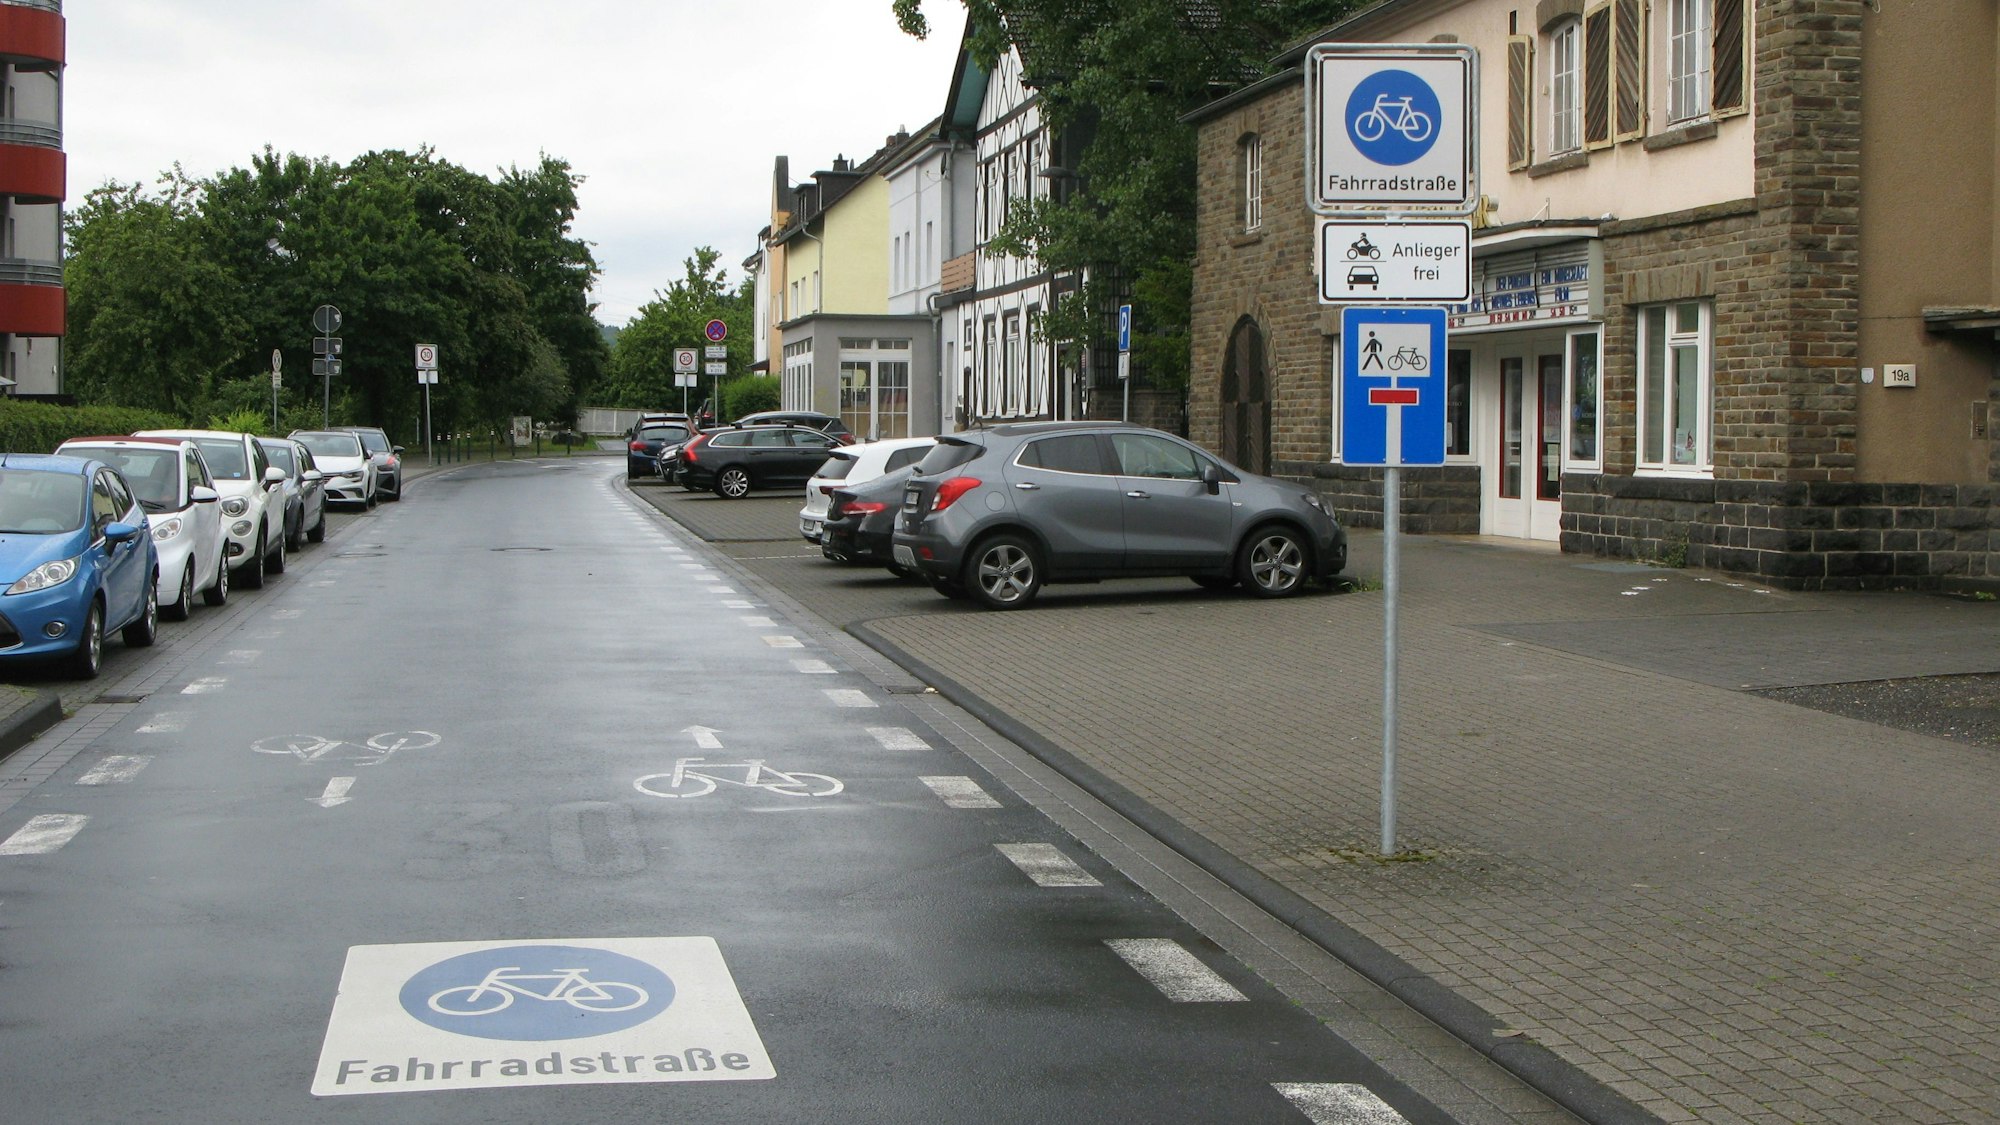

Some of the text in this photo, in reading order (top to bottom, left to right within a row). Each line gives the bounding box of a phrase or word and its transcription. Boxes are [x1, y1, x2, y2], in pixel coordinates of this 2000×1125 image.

[1328, 175, 1457, 191] Fahrradstraße
[1392, 242, 1461, 261] Anlieger
[1413, 265, 1440, 280] frei
[1120, 311, 1128, 345] P
[1891, 369, 1910, 382] 19a
[335, 1047, 752, 1086] Fahrradstraße
